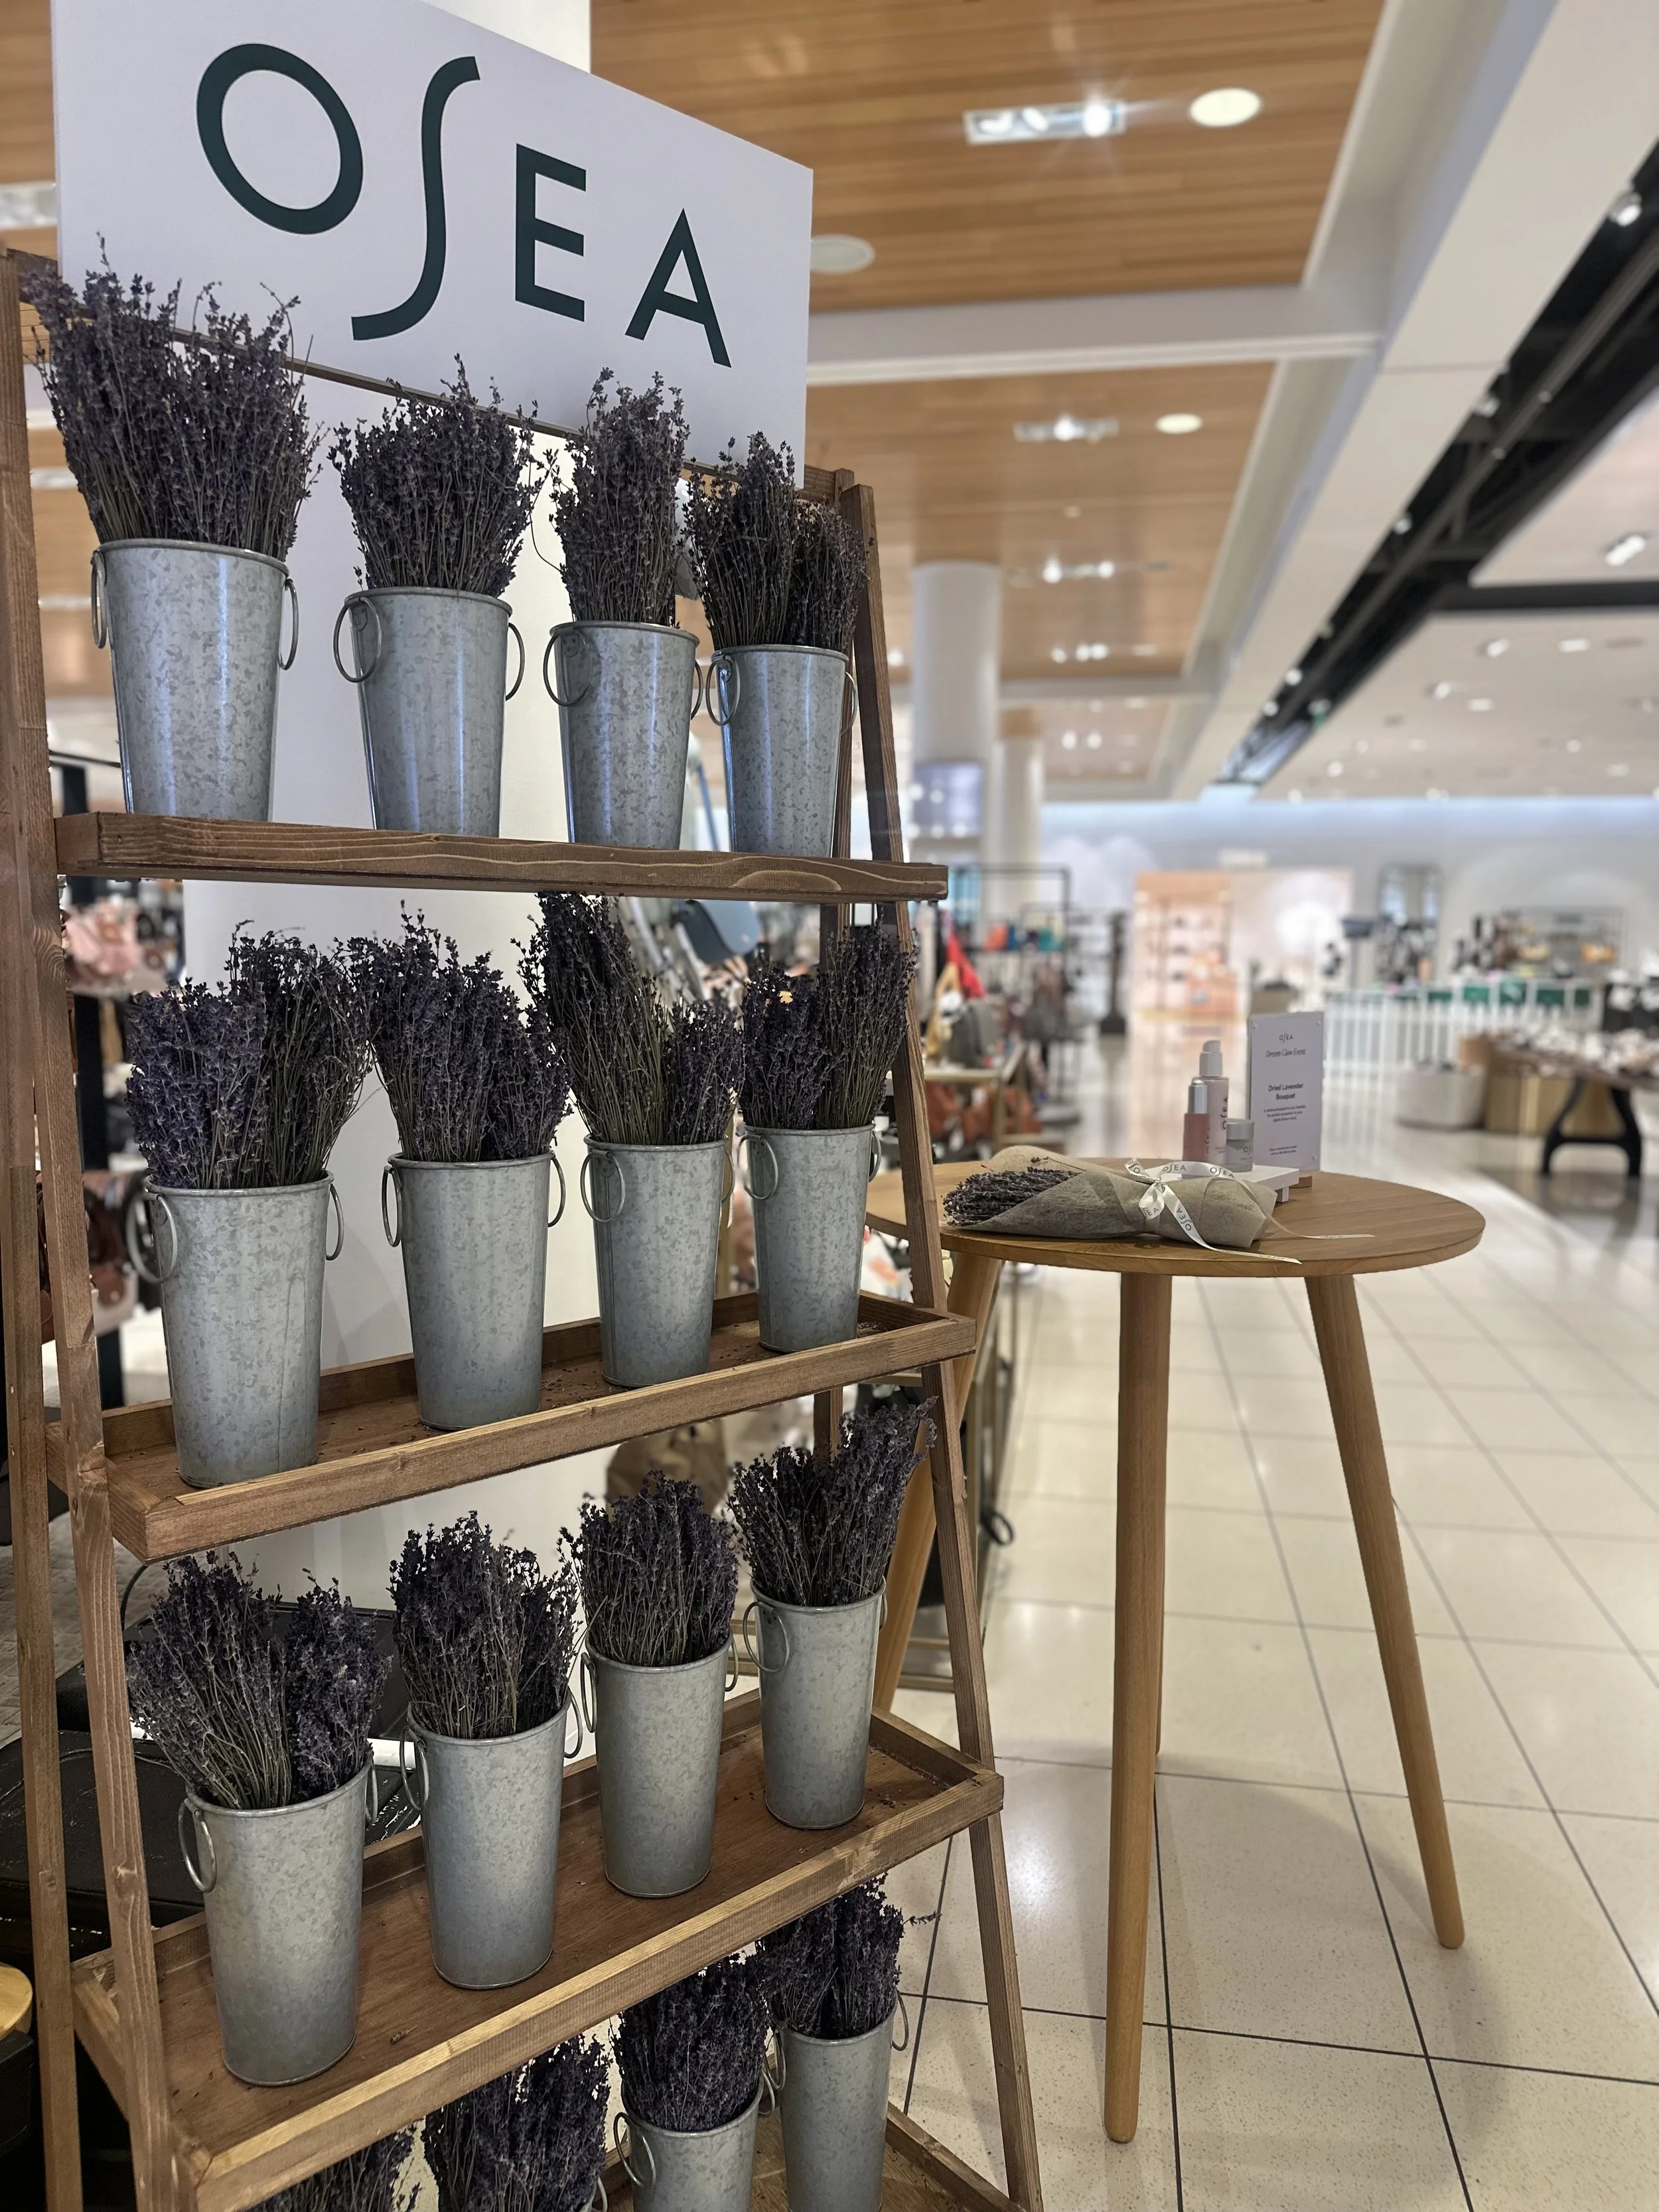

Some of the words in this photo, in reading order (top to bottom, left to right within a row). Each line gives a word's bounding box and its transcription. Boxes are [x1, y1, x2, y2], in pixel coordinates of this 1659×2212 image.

[196, 43, 732, 368] OSEA
[1279, 1032, 1293, 1043] OSEA
[1163, 1163, 1186, 1173] OSEA
[1210, 1167, 1235, 1179] OSEA
[1176, 1207, 1192, 1231] OSEA
